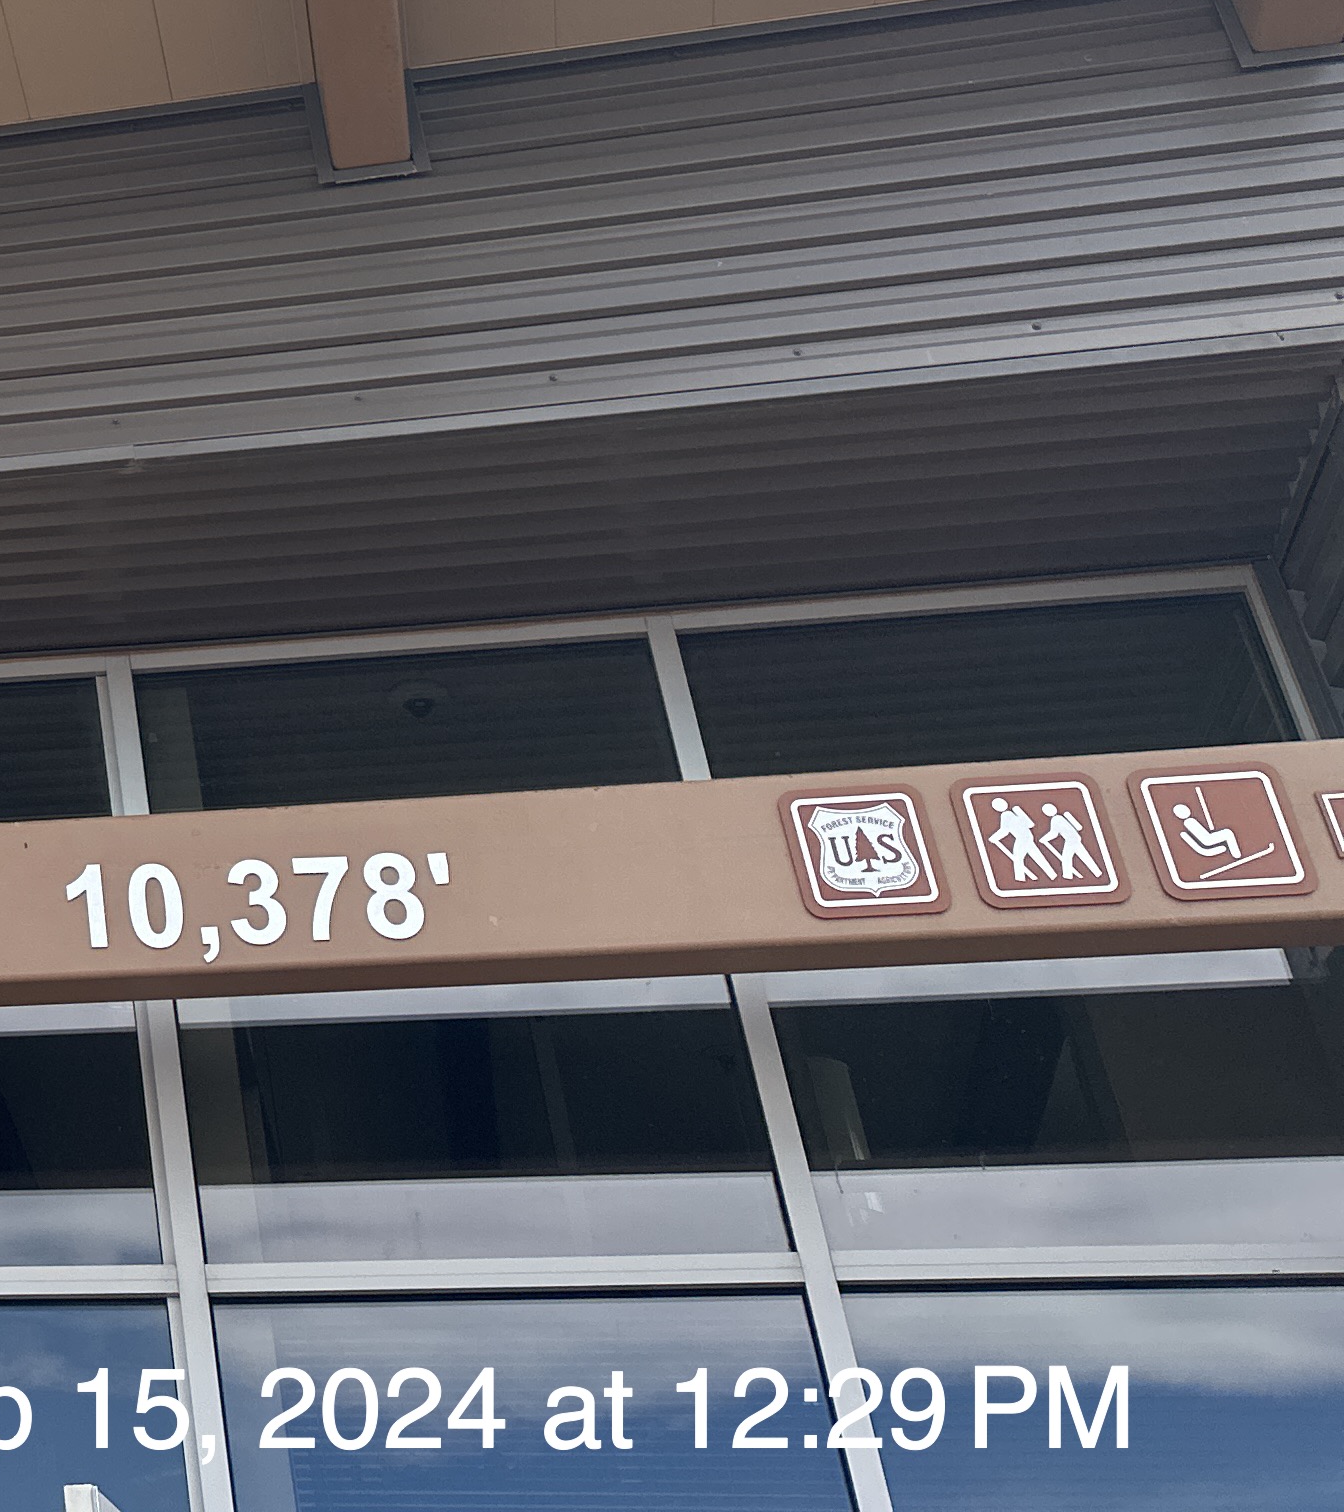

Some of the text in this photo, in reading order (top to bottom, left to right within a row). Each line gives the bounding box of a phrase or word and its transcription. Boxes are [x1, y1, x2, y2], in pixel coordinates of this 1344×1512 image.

[820, 815, 895, 833] FOREST SERVICE
[64, 851, 452, 963] 10,378'
